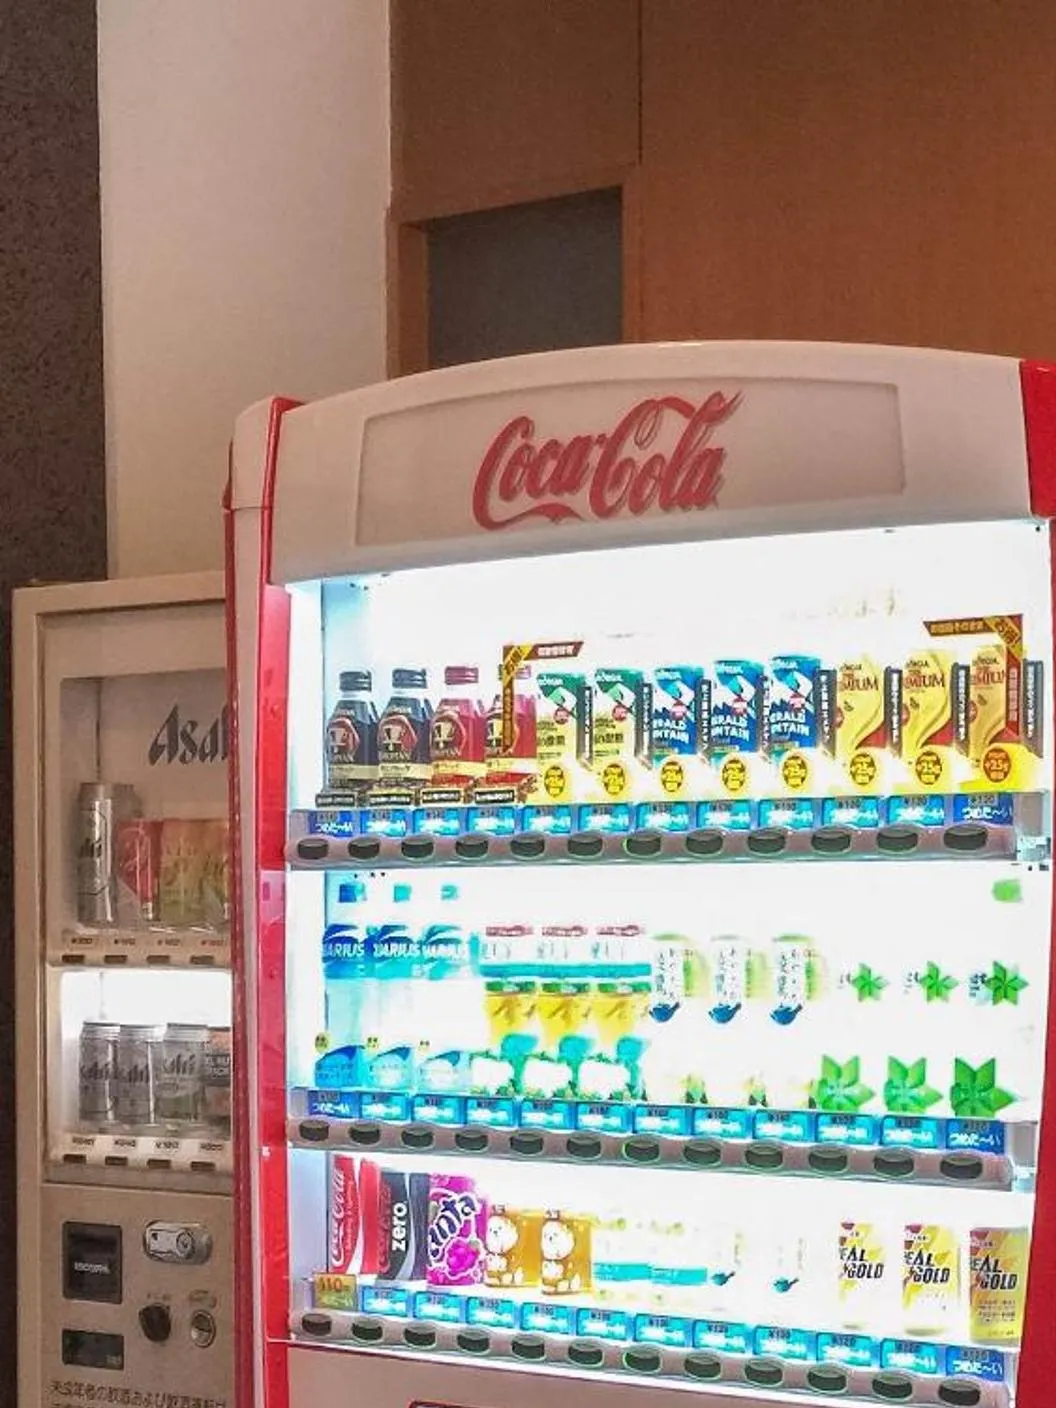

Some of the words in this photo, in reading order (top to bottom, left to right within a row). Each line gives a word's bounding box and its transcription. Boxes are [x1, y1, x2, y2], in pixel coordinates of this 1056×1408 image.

[149, 702, 229, 766] Asa
[848, 1264, 884, 1280] GOLD
[913, 1267, 951, 1285] GOLD
[980, 1274, 1018, 1291] GOLD
